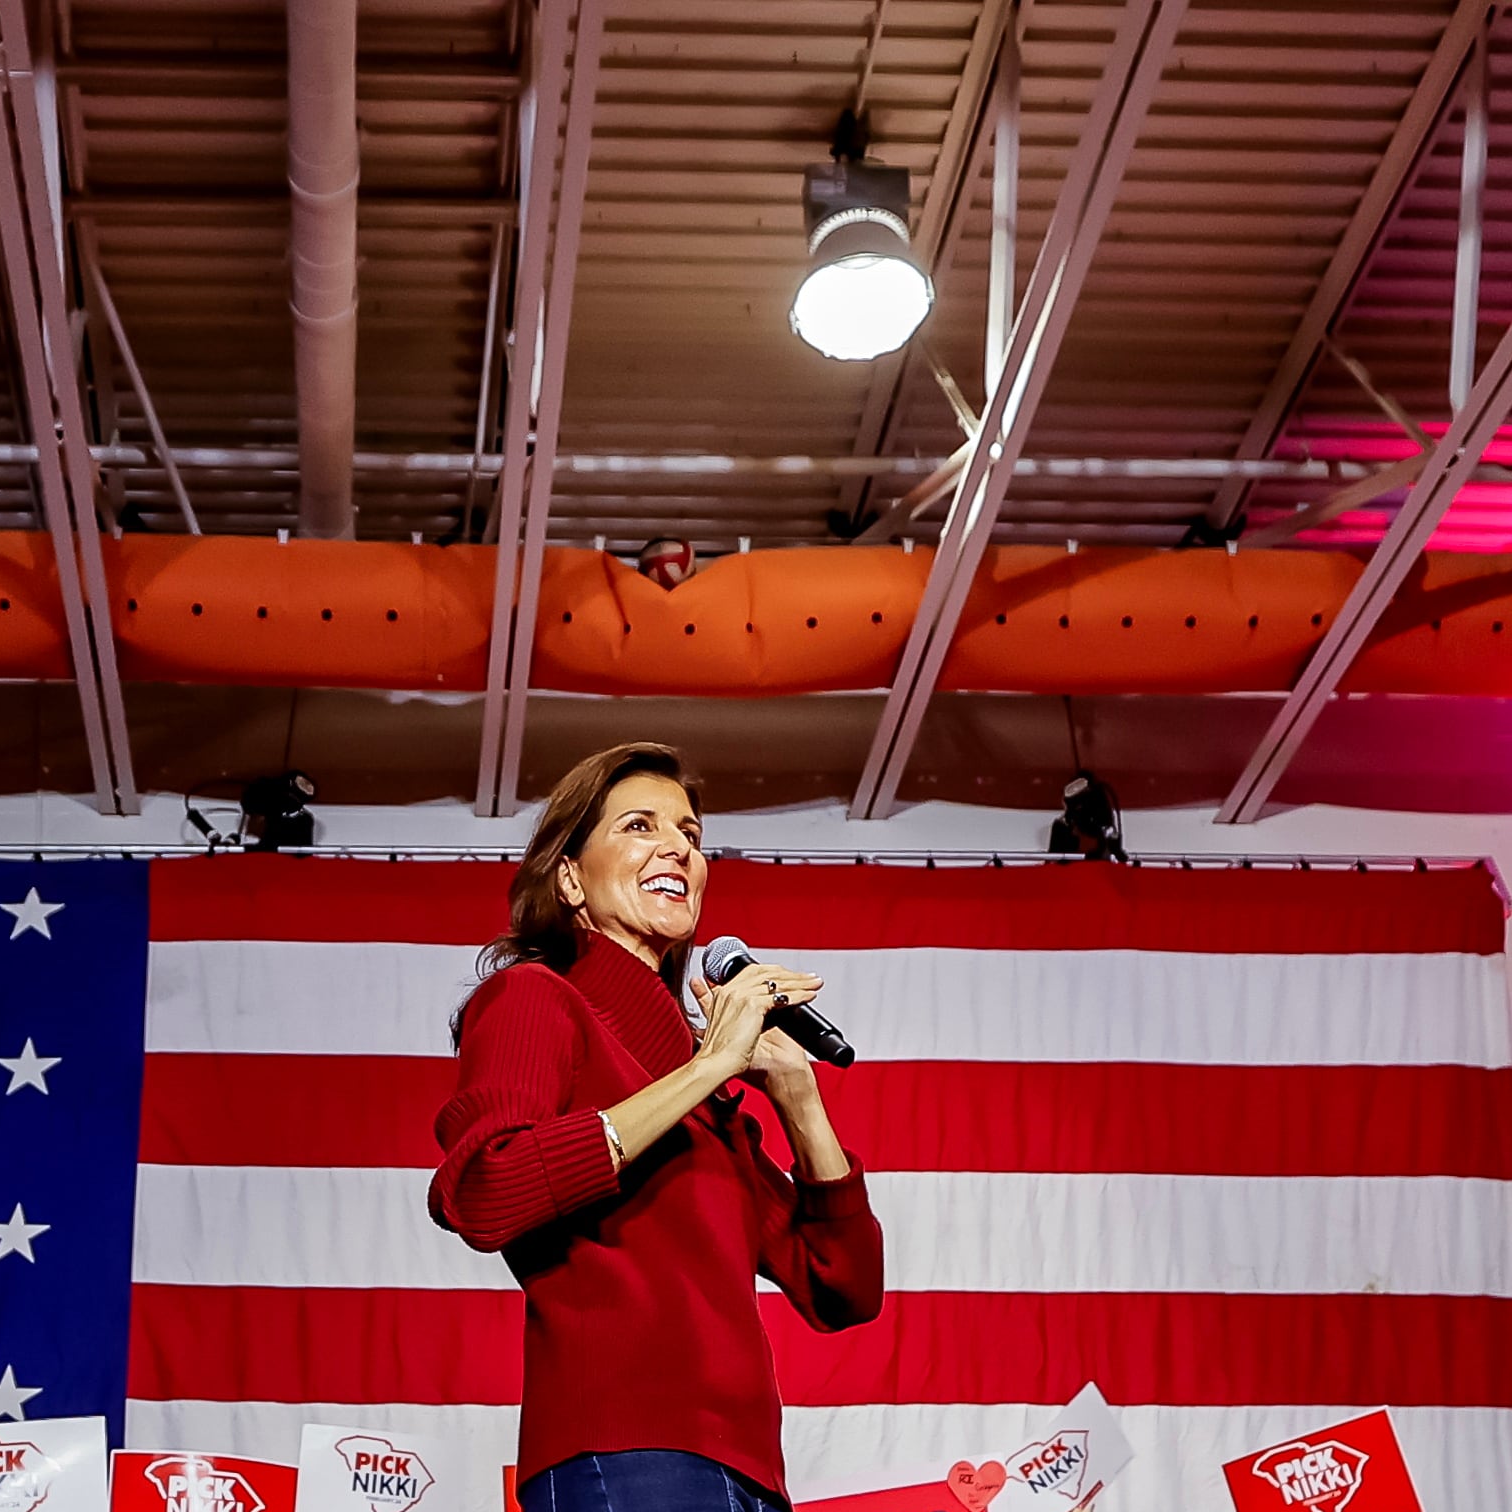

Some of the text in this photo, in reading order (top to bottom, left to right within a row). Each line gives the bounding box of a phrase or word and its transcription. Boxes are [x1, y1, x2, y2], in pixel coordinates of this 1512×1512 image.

[355, 1452, 411, 1476] PICK
[1019, 1437, 1069, 1479] PICK
[1028, 1445, 1084, 1493] NIKKI
[1275, 1448, 1339, 1485] PICK
[168, 1475, 237, 1500] PCK
[352, 1471, 417, 1498] NIKKI
[1281, 1463, 1353, 1504] NIKKI
